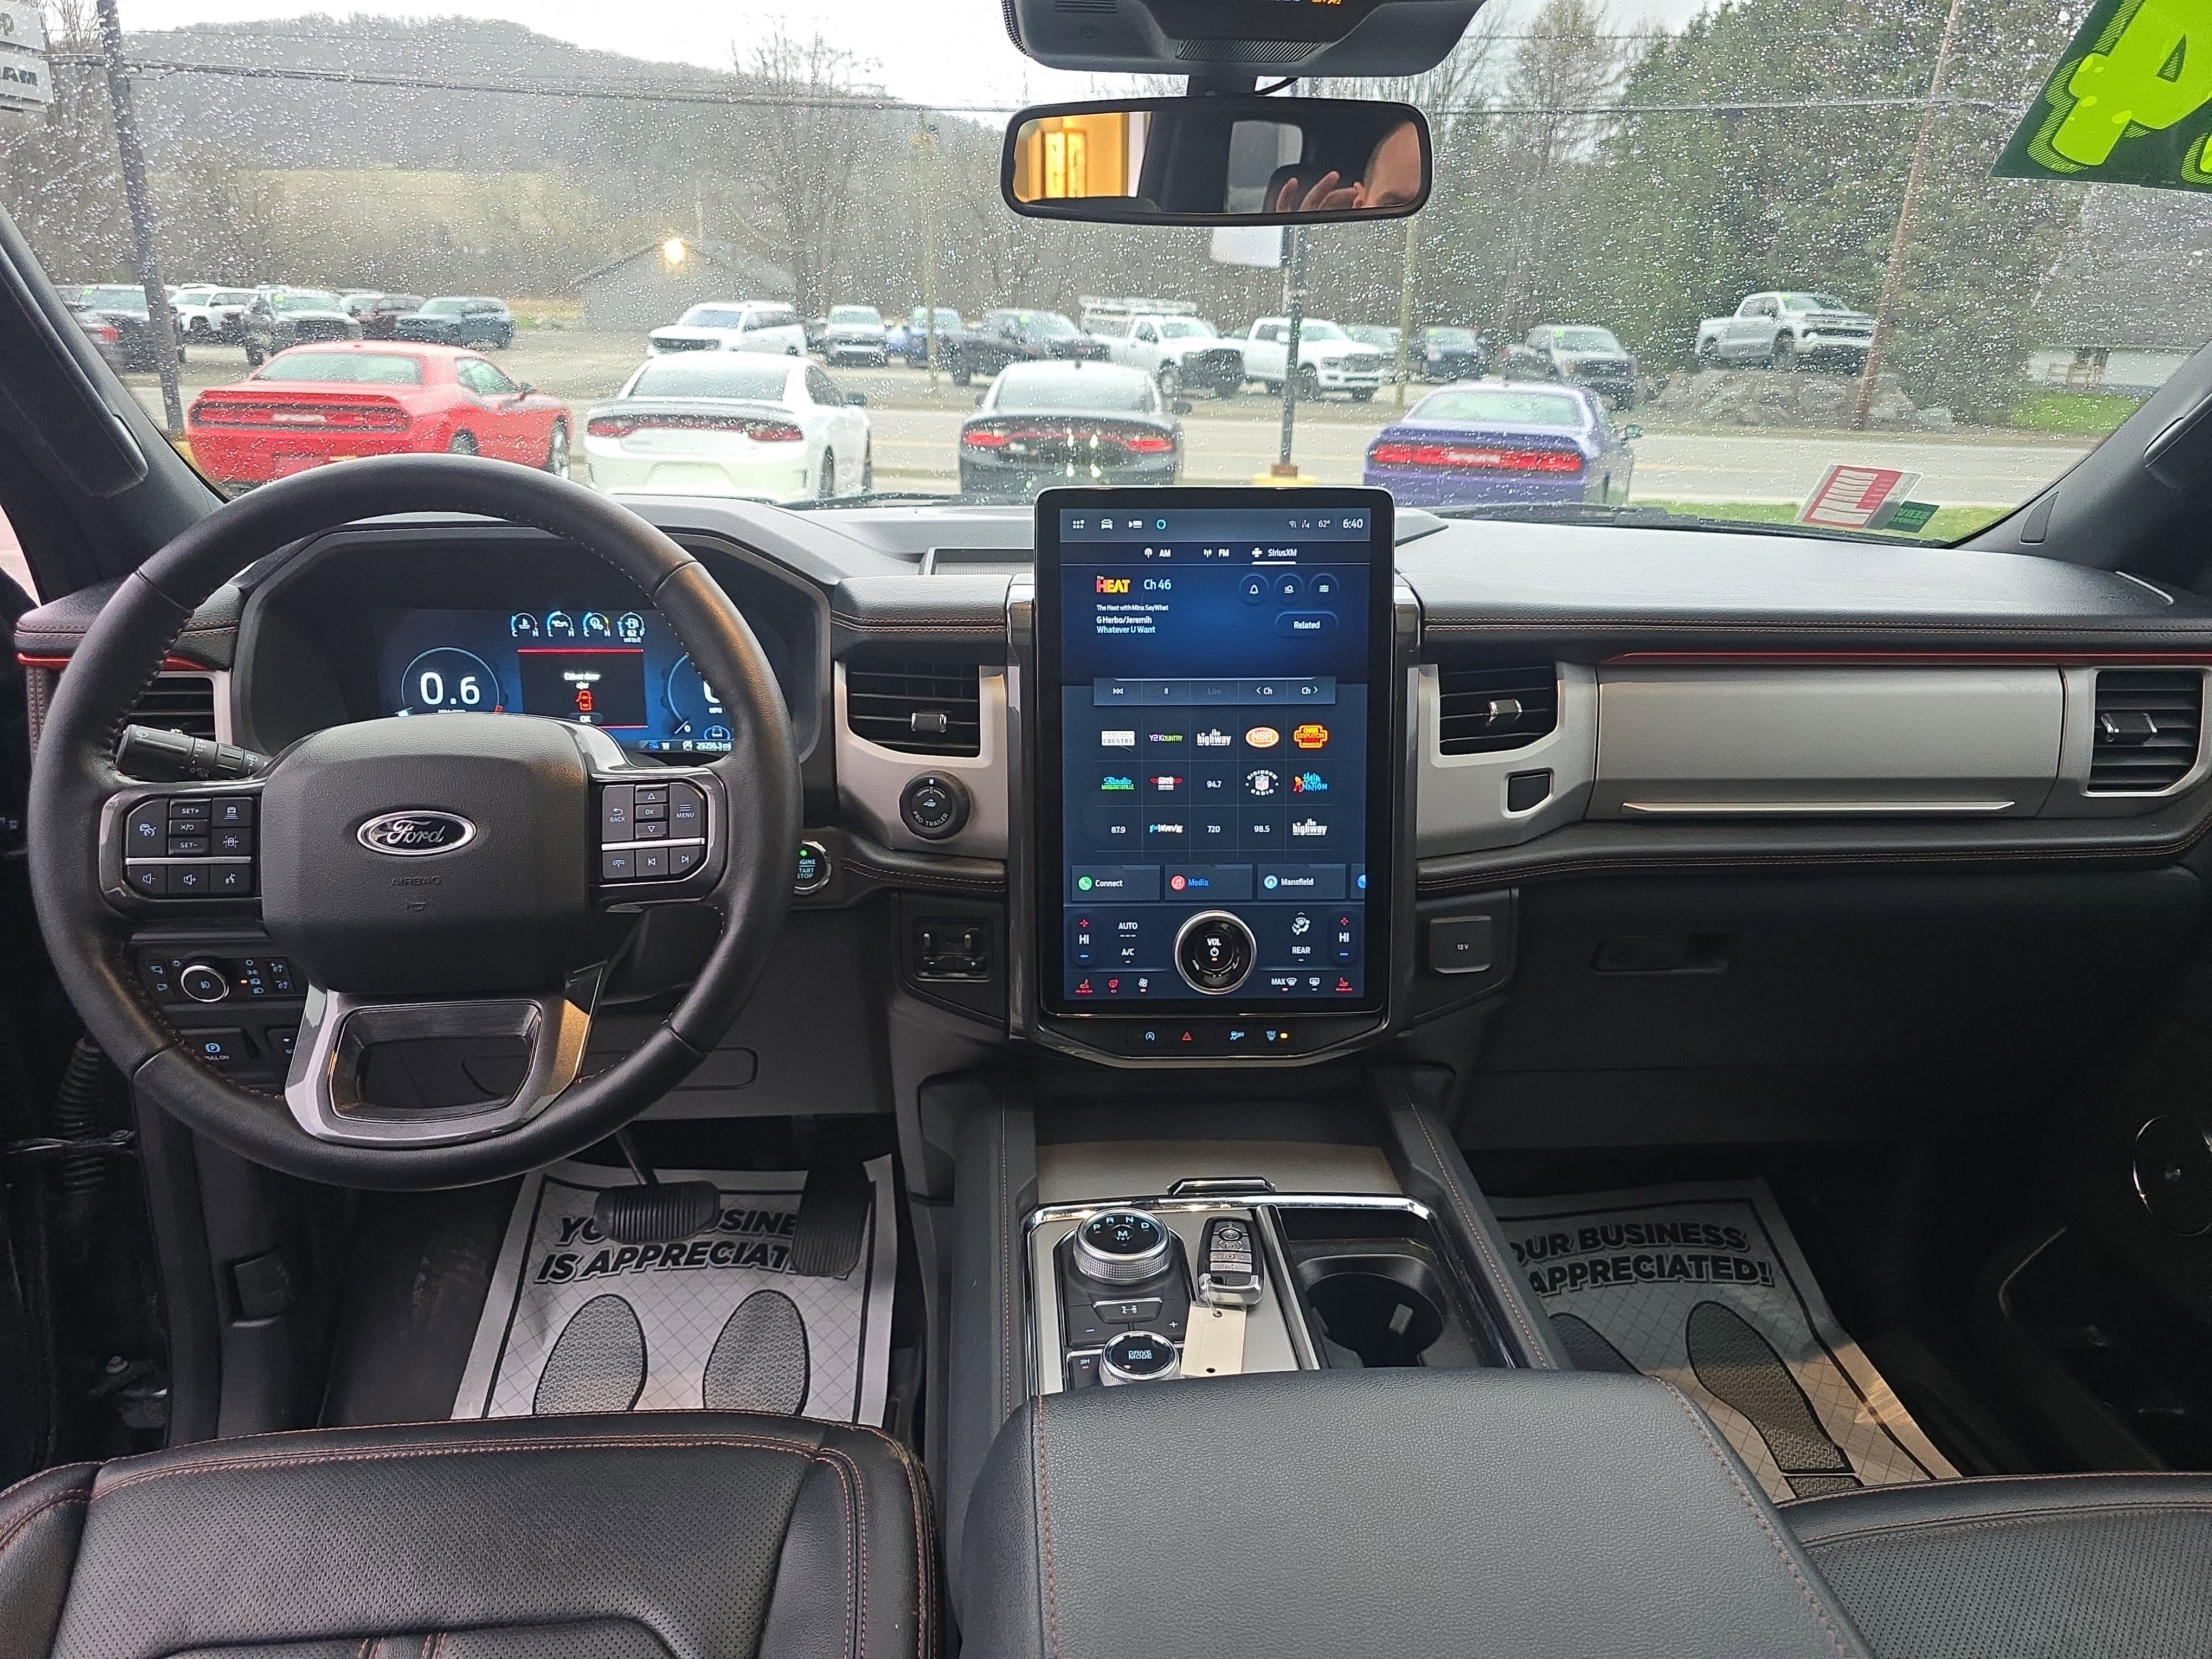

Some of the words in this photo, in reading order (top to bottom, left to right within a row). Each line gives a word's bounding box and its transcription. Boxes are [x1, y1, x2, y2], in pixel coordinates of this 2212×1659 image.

[1342, 519, 1364, 529] 6:40
[1159, 549, 1171, 557] AM
[1218, 549, 1229, 557] FM
[1268, 548, 1297, 557] SiriusXM
[1096, 579, 1130, 593] HEAT
[1144, 579, 1156, 590] Ch
[1158, 579, 1171, 590] 46
[1294, 621, 1320, 629] Related
[420, 672, 480, 705] 0.6
[1197, 733, 1231, 746] highway
[1303, 771, 1321, 782] HAIR
[1302, 782, 1327, 791] NATION
[912, 811, 923, 823] PRO
[925, 813, 949, 826] TRAILER
[387, 820, 446, 844] Ford
[1293, 822, 1328, 835] highway
[390, 876, 442, 886] AIRBAG
[1188, 878, 1209, 886] Media
[1281, 878, 1314, 886] Mansfield
[1079, 935, 1089, 944] HI
[1339, 933, 1349, 942] HI
[1577, 1223, 1751, 1254] BUSINESS
[533, 1251, 584, 1284] IS
[1528, 1252, 1775, 1298] APPRECIATED!
